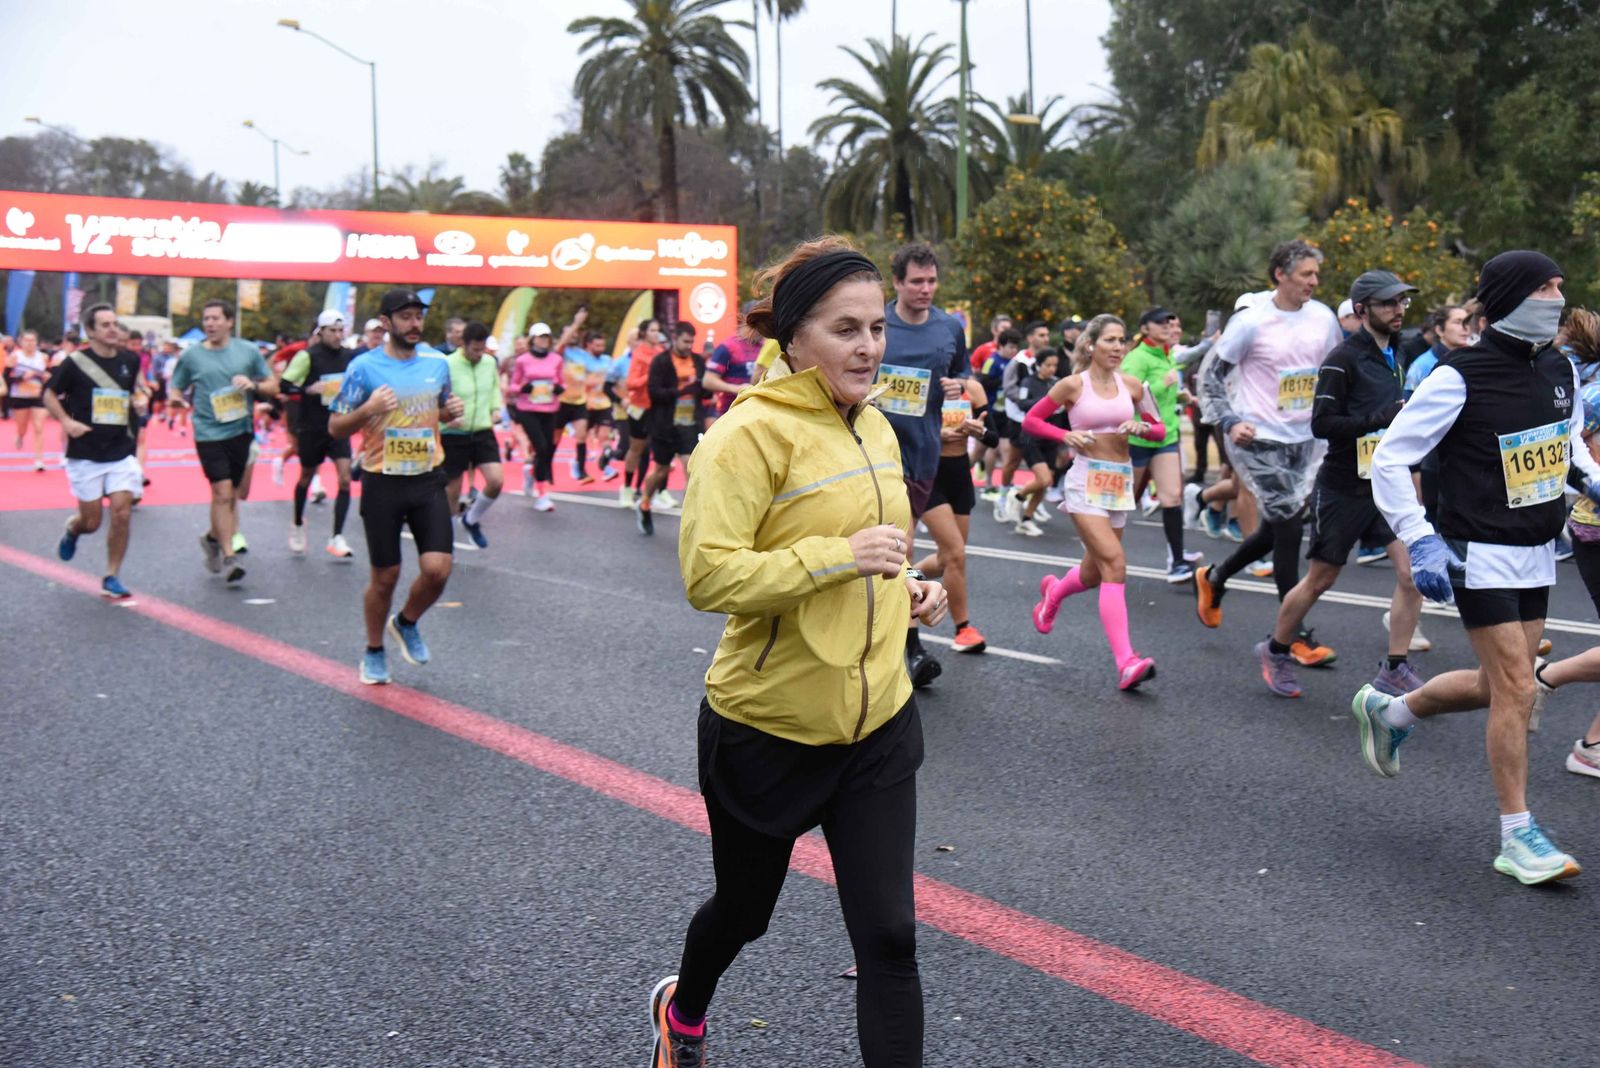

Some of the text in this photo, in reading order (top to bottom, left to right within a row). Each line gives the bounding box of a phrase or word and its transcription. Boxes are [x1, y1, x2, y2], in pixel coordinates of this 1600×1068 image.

[1283, 377, 1315, 392] 18175
[390, 440, 428, 454] 15344
[1362, 439, 1381, 456] 17
[1509, 441, 1564, 474] 16132
[1094, 473, 1123, 489] 5743
